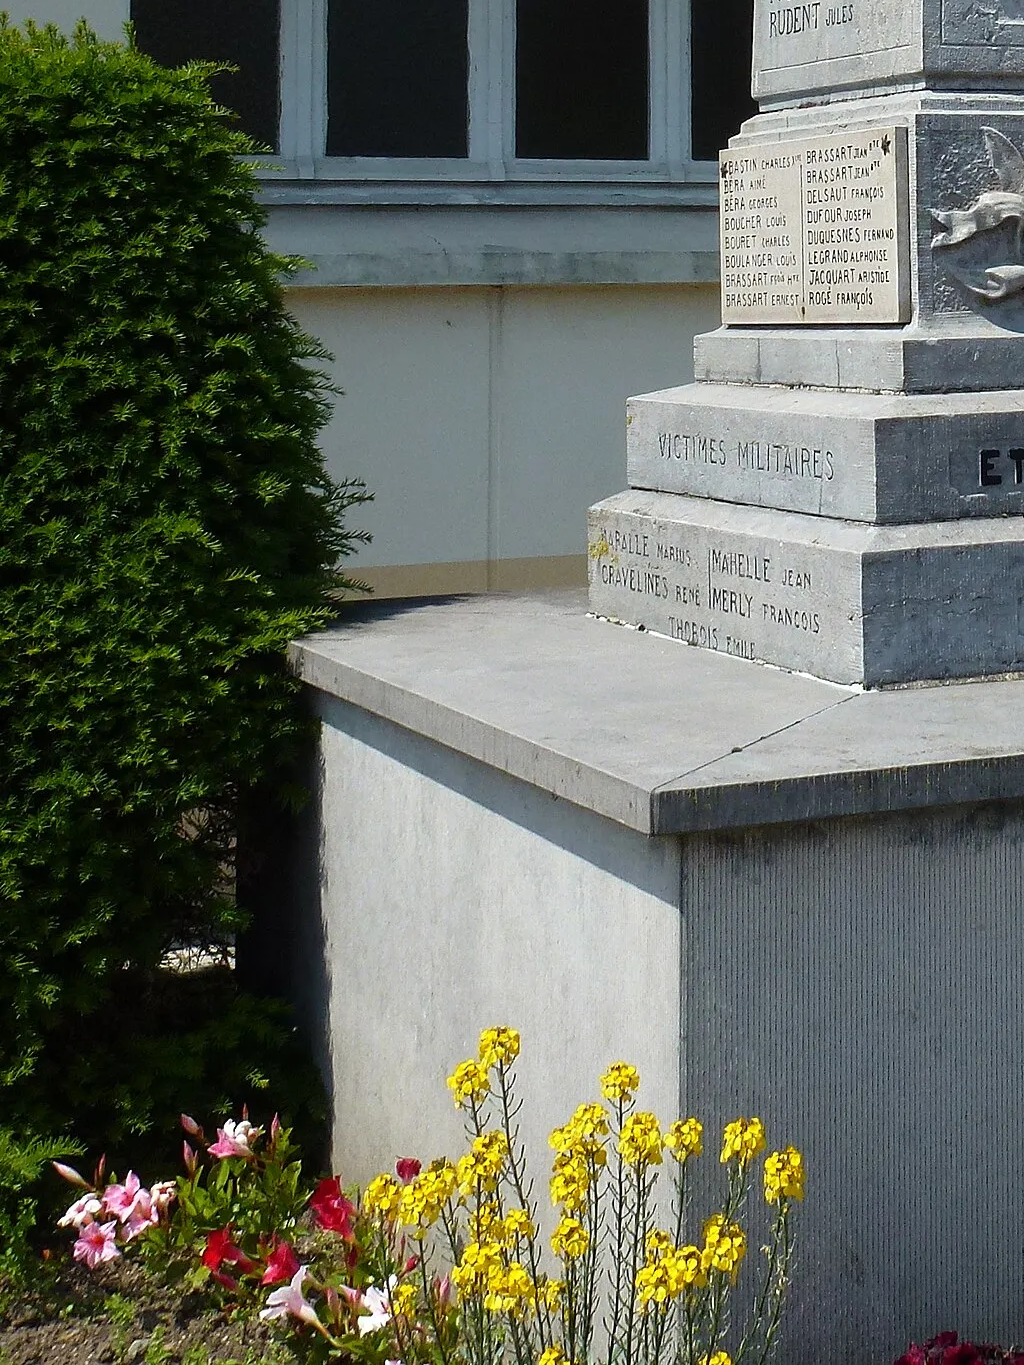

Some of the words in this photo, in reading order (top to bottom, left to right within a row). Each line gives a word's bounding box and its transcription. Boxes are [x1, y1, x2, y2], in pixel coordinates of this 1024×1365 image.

[770, 2, 820, 38] RUDENT
[826, 4, 854, 26] JULES
[806, 146, 852, 164] BRASSART
[728, 158, 757, 175] BASTIN
[807, 166, 853, 183] BRASSART
[807, 186, 847, 204] DELSAUT
[725, 214, 762, 230] BOUCHER
[766, 212, 786, 228] LOUIS
[807, 208, 842, 224] DUFOUR
[844, 208, 872, 222] JOSEPH
[725, 234, 756, 250] BOURET
[762, 236, 790, 248] CHARLES
[808, 228, 861, 245] DUQUESNES
[864, 228, 894, 241] FERNAND
[726, 253, 772, 268] BOULANGER
[776, 252, 797, 266] LOUIS
[808, 250, 849, 265] LEGRAND
[850, 250, 888, 263] ALPHONSE
[726, 272, 768, 288] BRASSART
[808, 268, 856, 285] JACQUART
[858, 266, 890, 284] ARISTIDE
[726, 292, 768, 307] BRASSART
[772, 294, 800, 306] ERNEST
[809, 287, 832, 305] ROGÉ
[836, 288, 873, 310] FRANÇOIS
[658, 433, 727, 466] VICTIMES
[737, 440, 835, 481] MILITAIRES
[656, 543, 692, 566] MARIUS
[712, 549, 771, 582] MAHELLE
[782, 569, 811, 590] JEAN
[602, 564, 669, 599] GRAVELINES
[712, 588, 753, 618] MERLY
[668, 616, 718, 650] THOBOIS
[726, 635, 756, 660] EMILE
